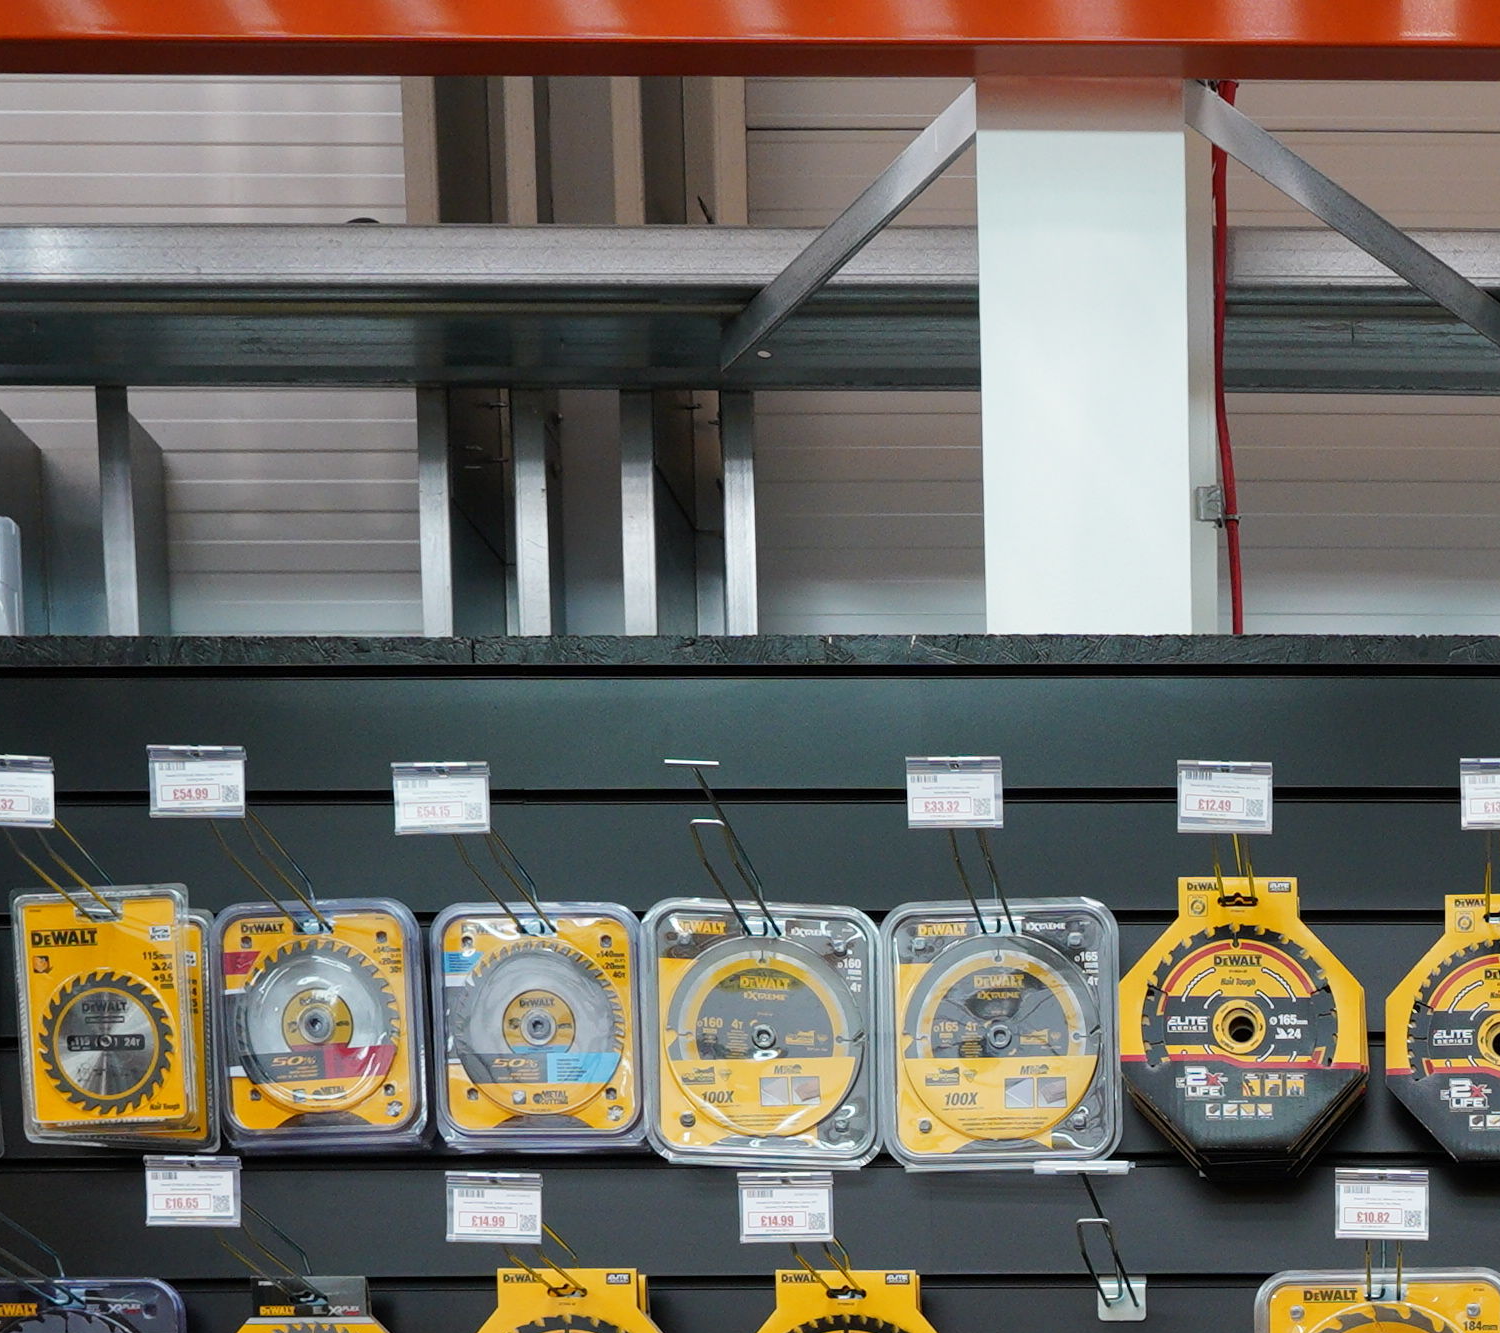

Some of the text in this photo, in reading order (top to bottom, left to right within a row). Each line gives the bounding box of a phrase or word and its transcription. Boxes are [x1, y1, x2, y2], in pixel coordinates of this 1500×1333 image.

[172, 789, 208, 801] £54.99
[924, 801, 957, 812] £33.32
[1198, 800, 1231, 811] £12.49
[31, 928, 97, 947] DEWALT
[165, 1198, 198, 1208] £16.65
[473, 1216, 504, 1227] £14.99
[759, 1216, 795, 1227] £14.99
[1356, 1212, 1390, 1224] £10.82
